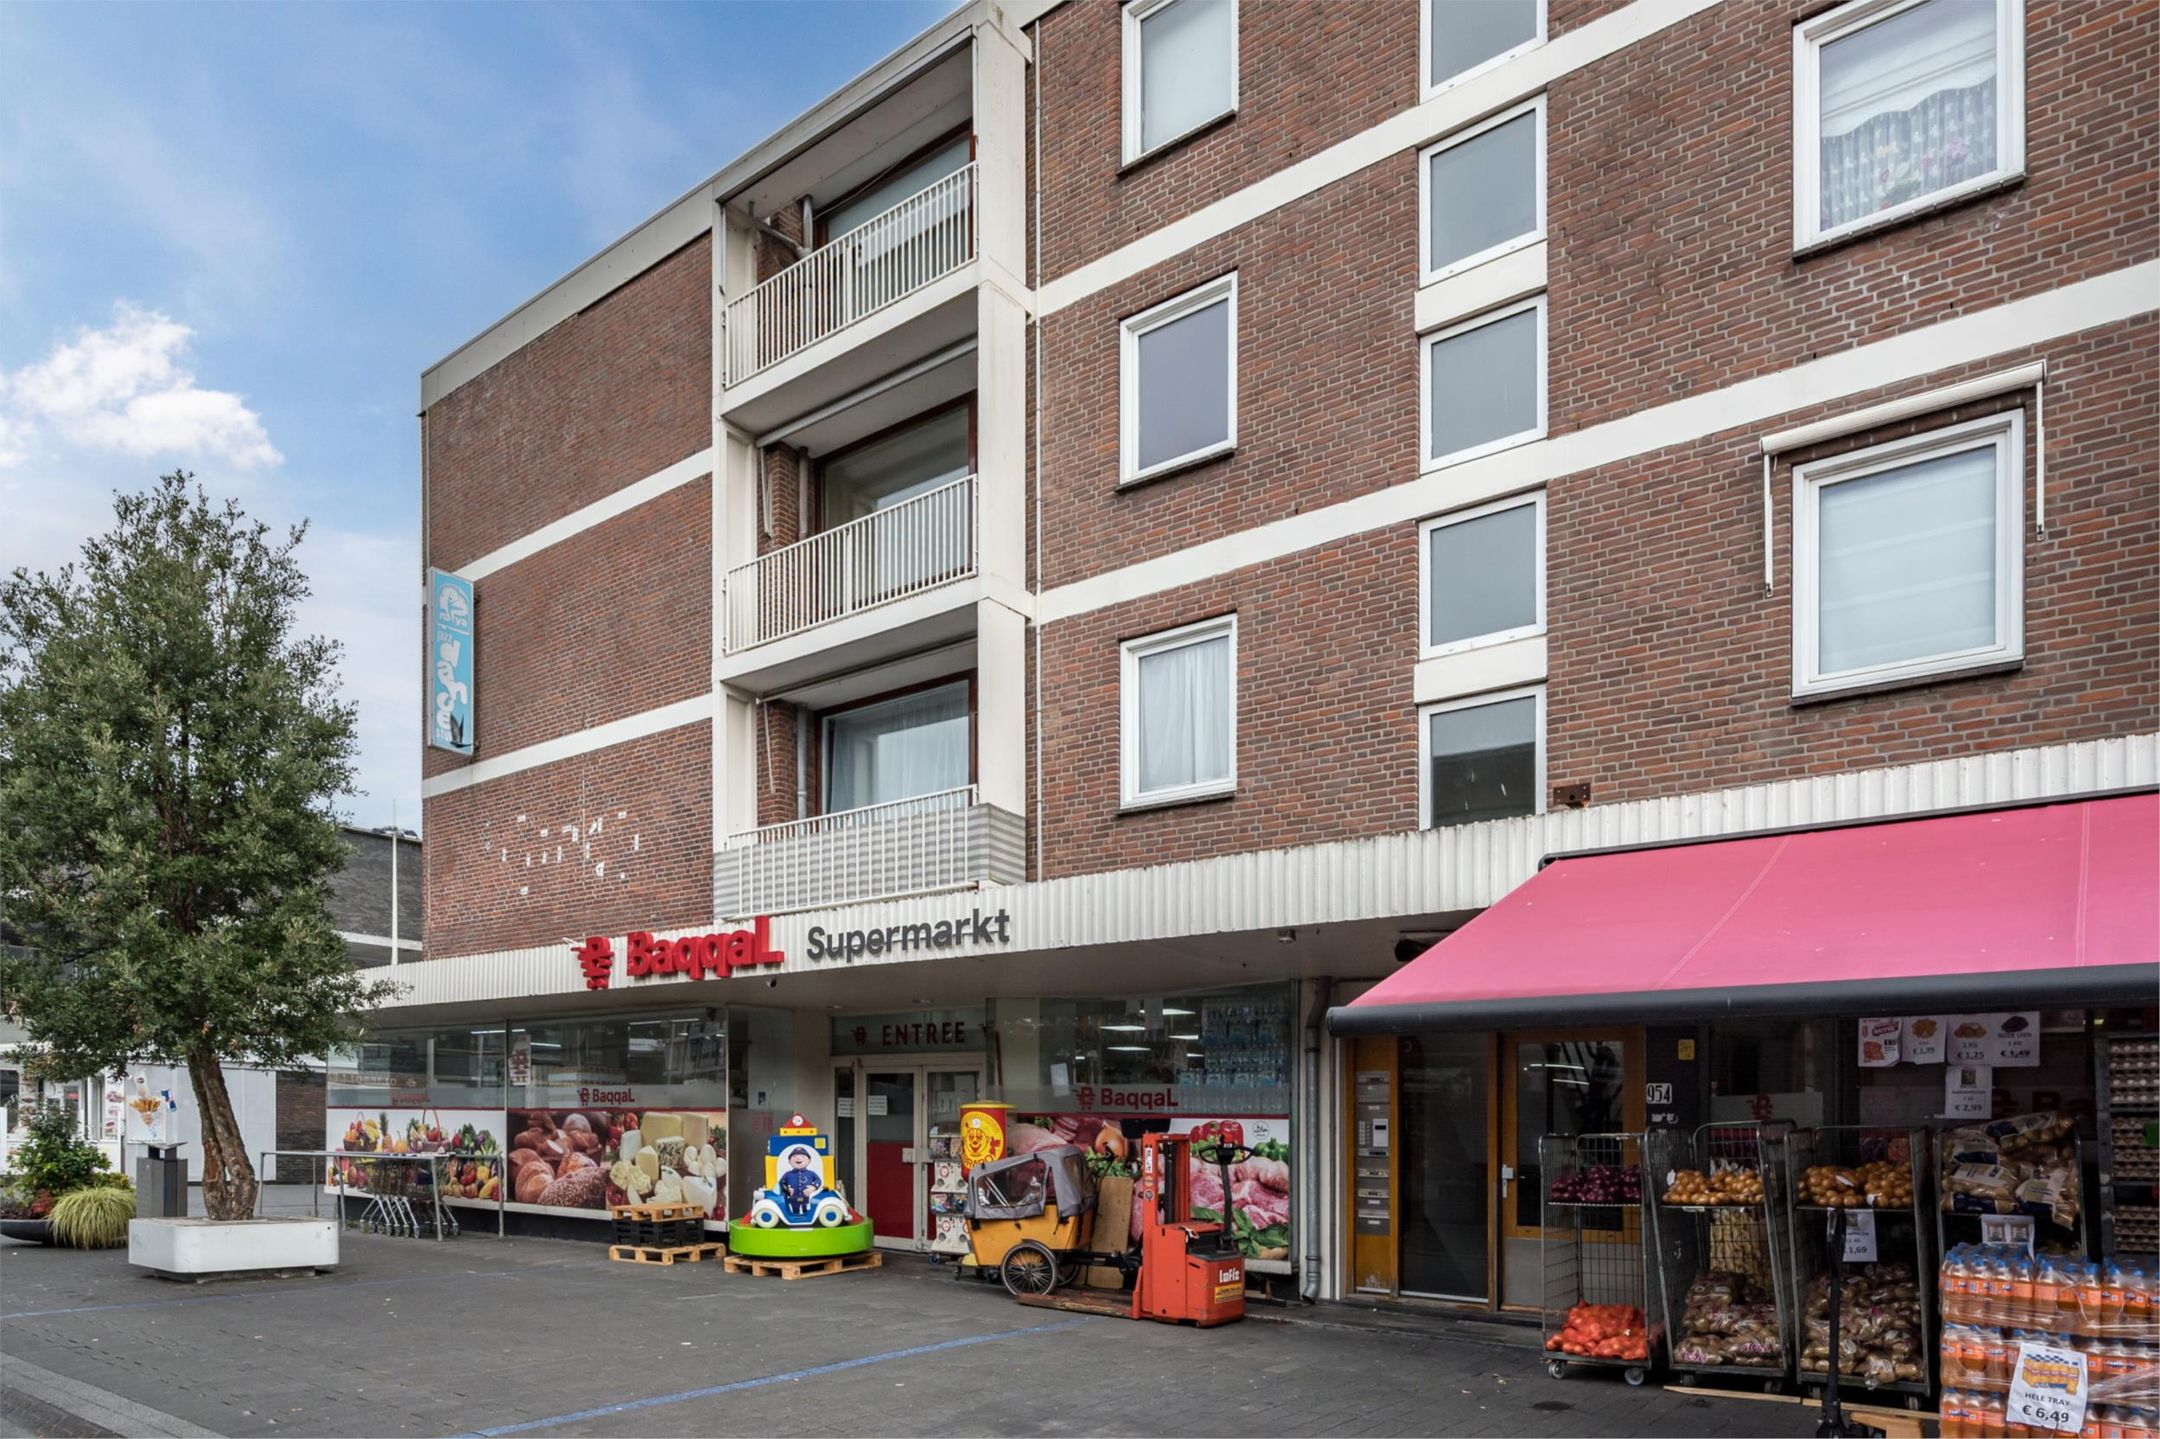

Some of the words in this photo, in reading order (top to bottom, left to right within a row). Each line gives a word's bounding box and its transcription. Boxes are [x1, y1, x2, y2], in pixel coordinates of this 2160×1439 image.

[626, 915, 785, 980] BaqqaL
[806, 908, 1010, 962] Supermarkt
[881, 1022, 966, 1048] ENTREE
[592, 1088, 635, 1105] BaqqaL
[1101, 1088, 1178, 1109] BaqqaL
[1647, 1084, 1670, 1103] 954
[2025, 1392, 2045, 1402] HELE
[2048, 1396, 2071, 1406] TRAY
[2022, 1404, 2032, 1416] €
[2035, 1407, 2069, 1423] 6,49
